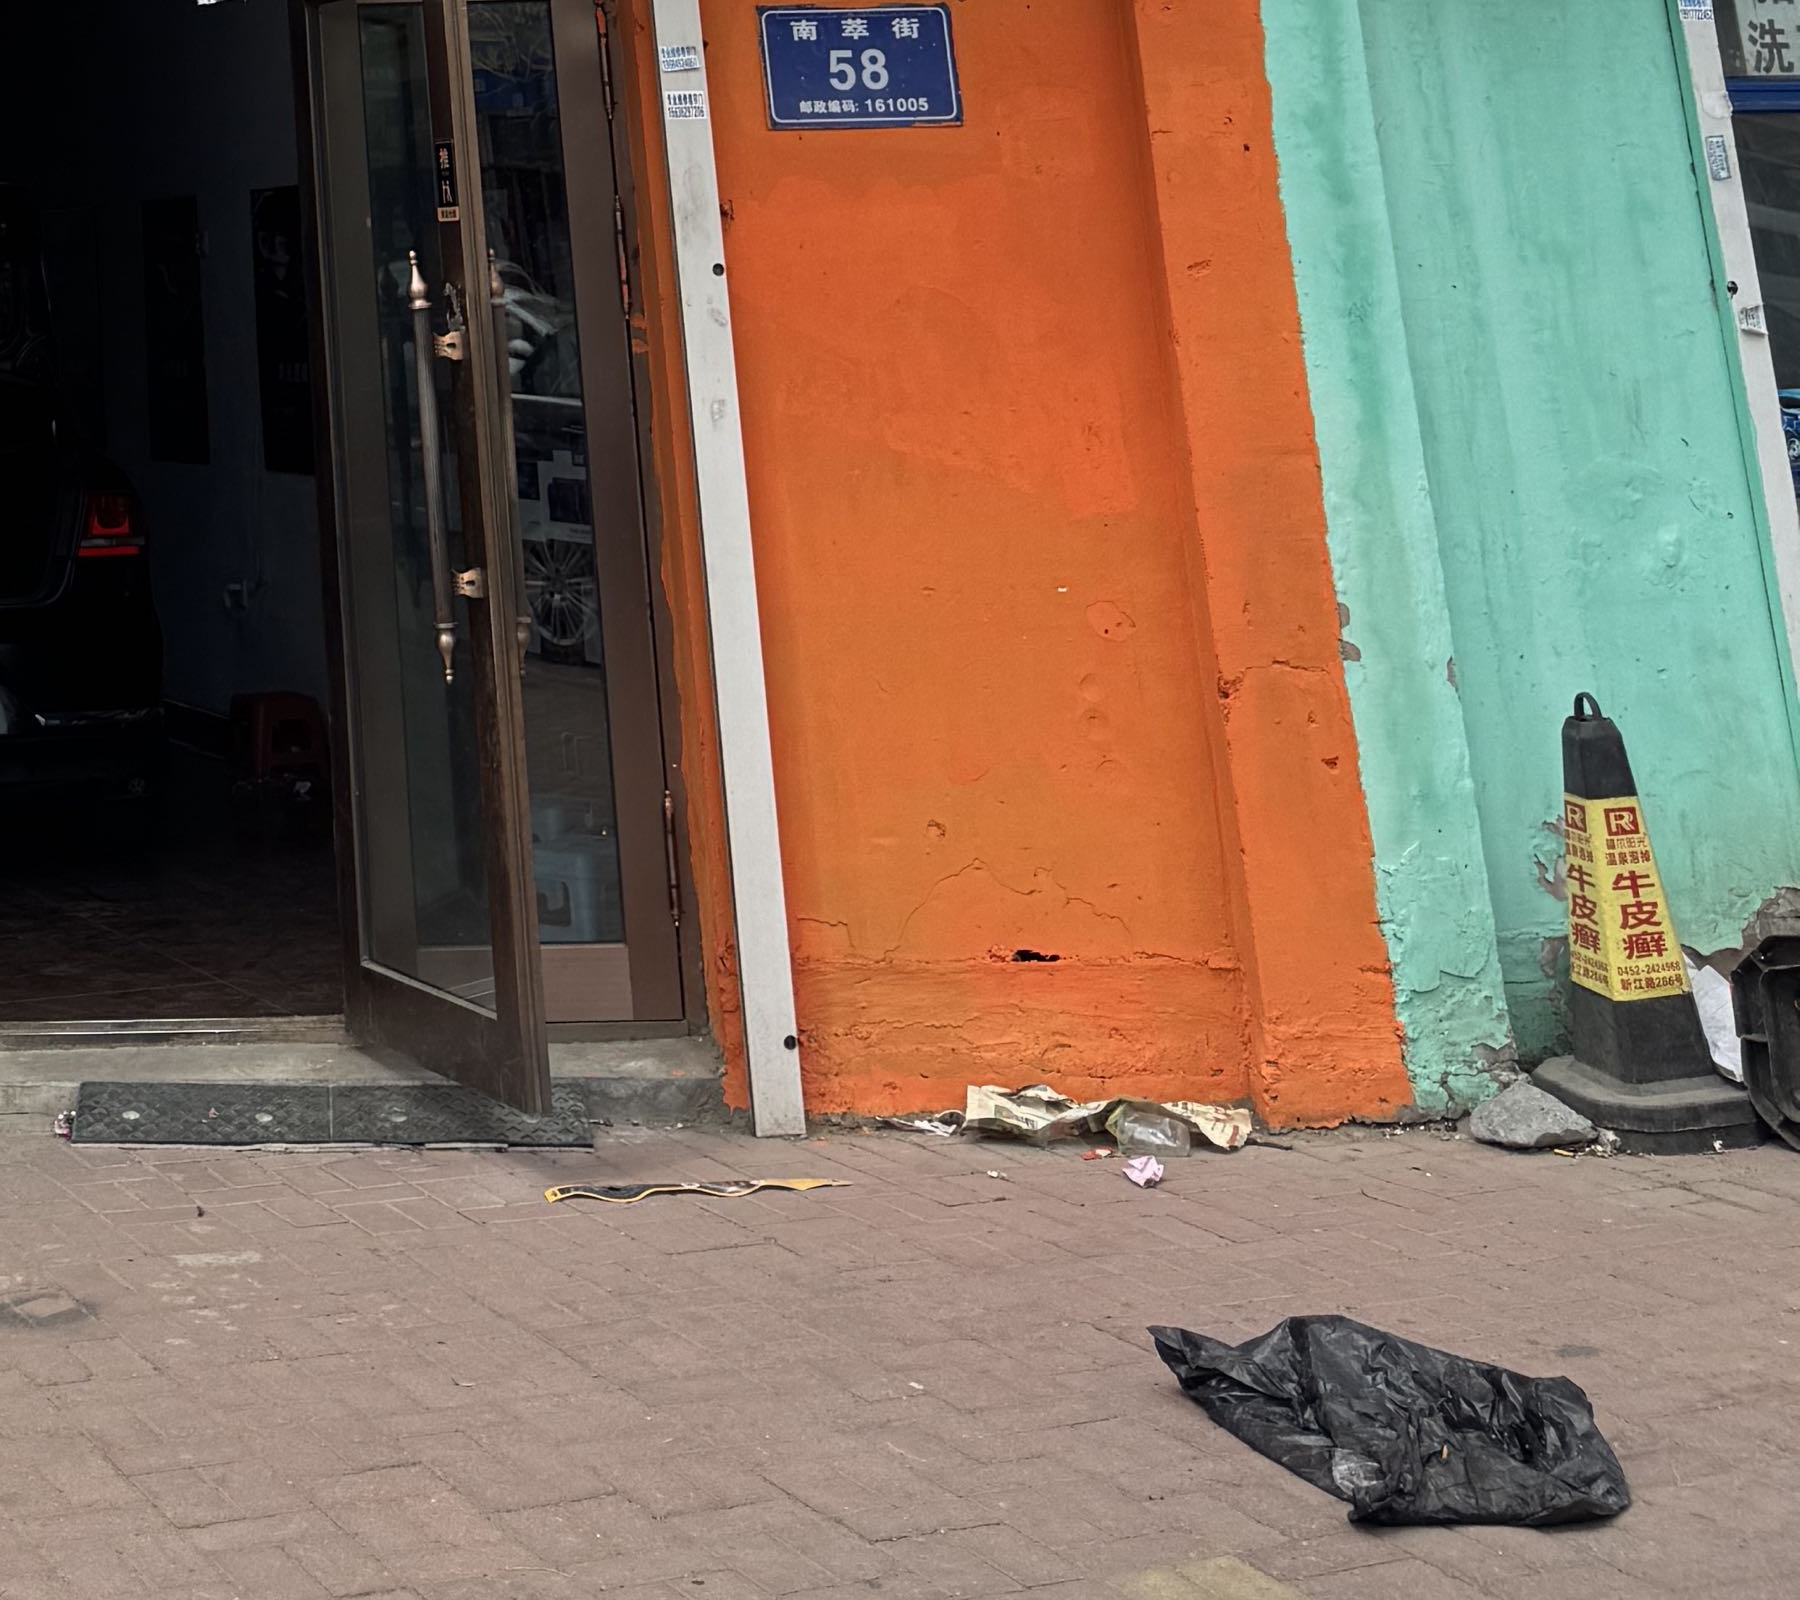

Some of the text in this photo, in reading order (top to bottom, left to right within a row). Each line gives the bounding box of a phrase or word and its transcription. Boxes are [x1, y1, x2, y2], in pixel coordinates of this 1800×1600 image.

[790, 17, 920, 41] 南萃街
[1747, 18, 1800, 75] 洗
[829, 49, 889, 91] 58
[864, 97, 929, 113] 161005
[1612, 870, 1668, 960] 牛皮癣
